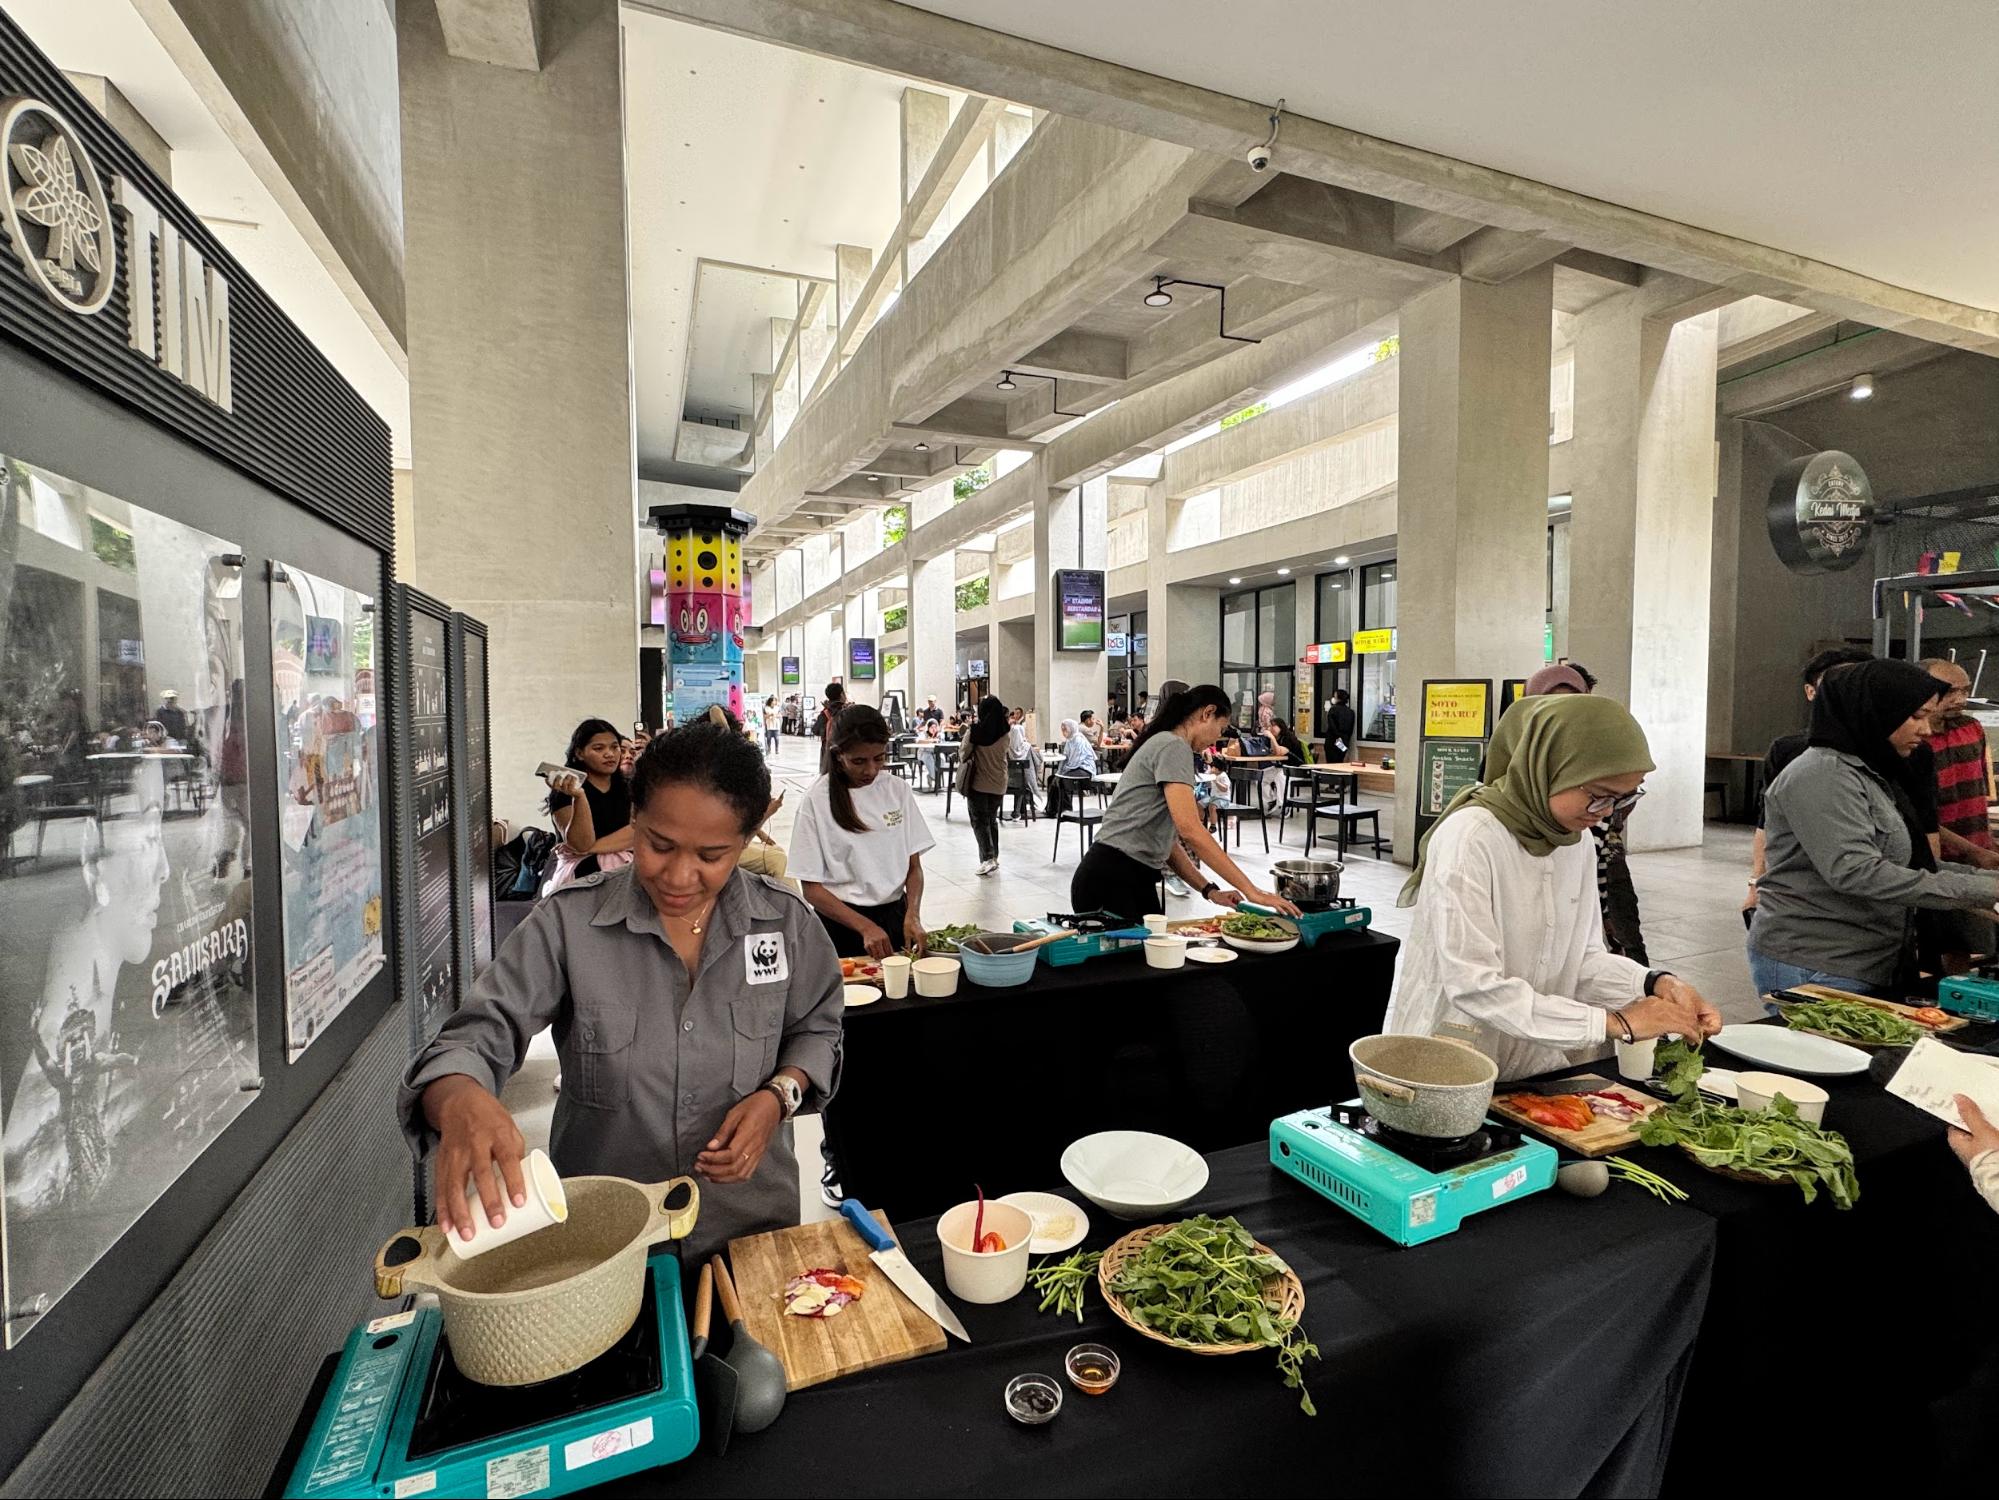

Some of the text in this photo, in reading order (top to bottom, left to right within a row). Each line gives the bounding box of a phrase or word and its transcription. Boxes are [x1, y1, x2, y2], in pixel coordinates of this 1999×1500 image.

[112, 174, 233, 414] TIM
[1811, 502, 1834, 517] Kedai
[1431, 700, 1458, 708] SOTO
[151, 918, 249, 1020] SAMSARA
[754, 967, 778, 977] WWF
